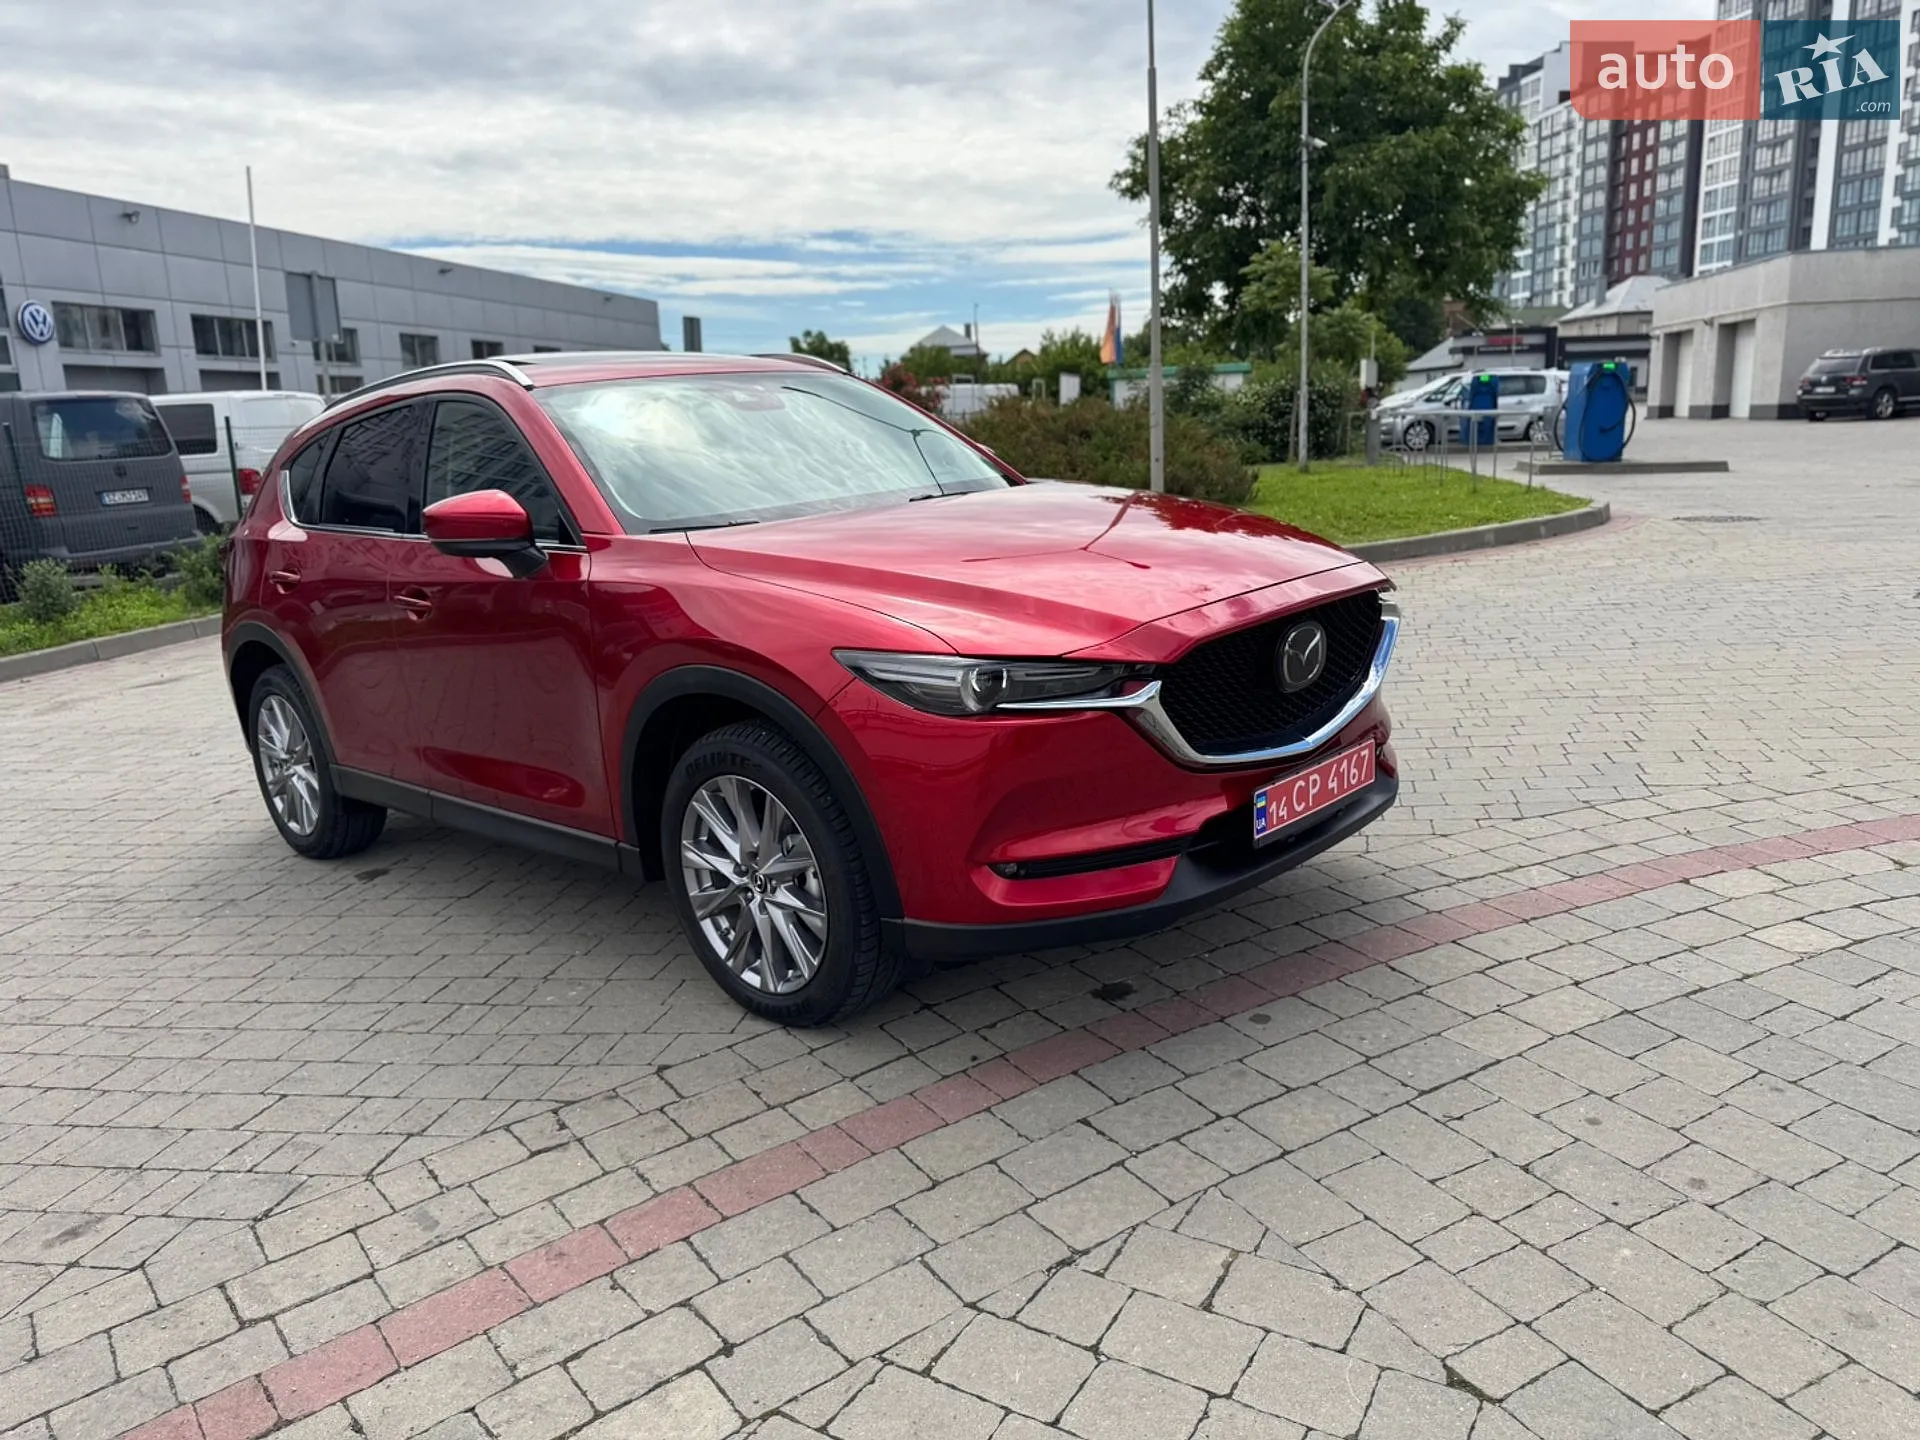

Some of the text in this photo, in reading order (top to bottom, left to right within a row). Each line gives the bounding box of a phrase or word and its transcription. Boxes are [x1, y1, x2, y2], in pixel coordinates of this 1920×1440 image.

[1269, 748, 1369, 825] 14 CP 4167
[1255, 817, 1267, 830] UA
